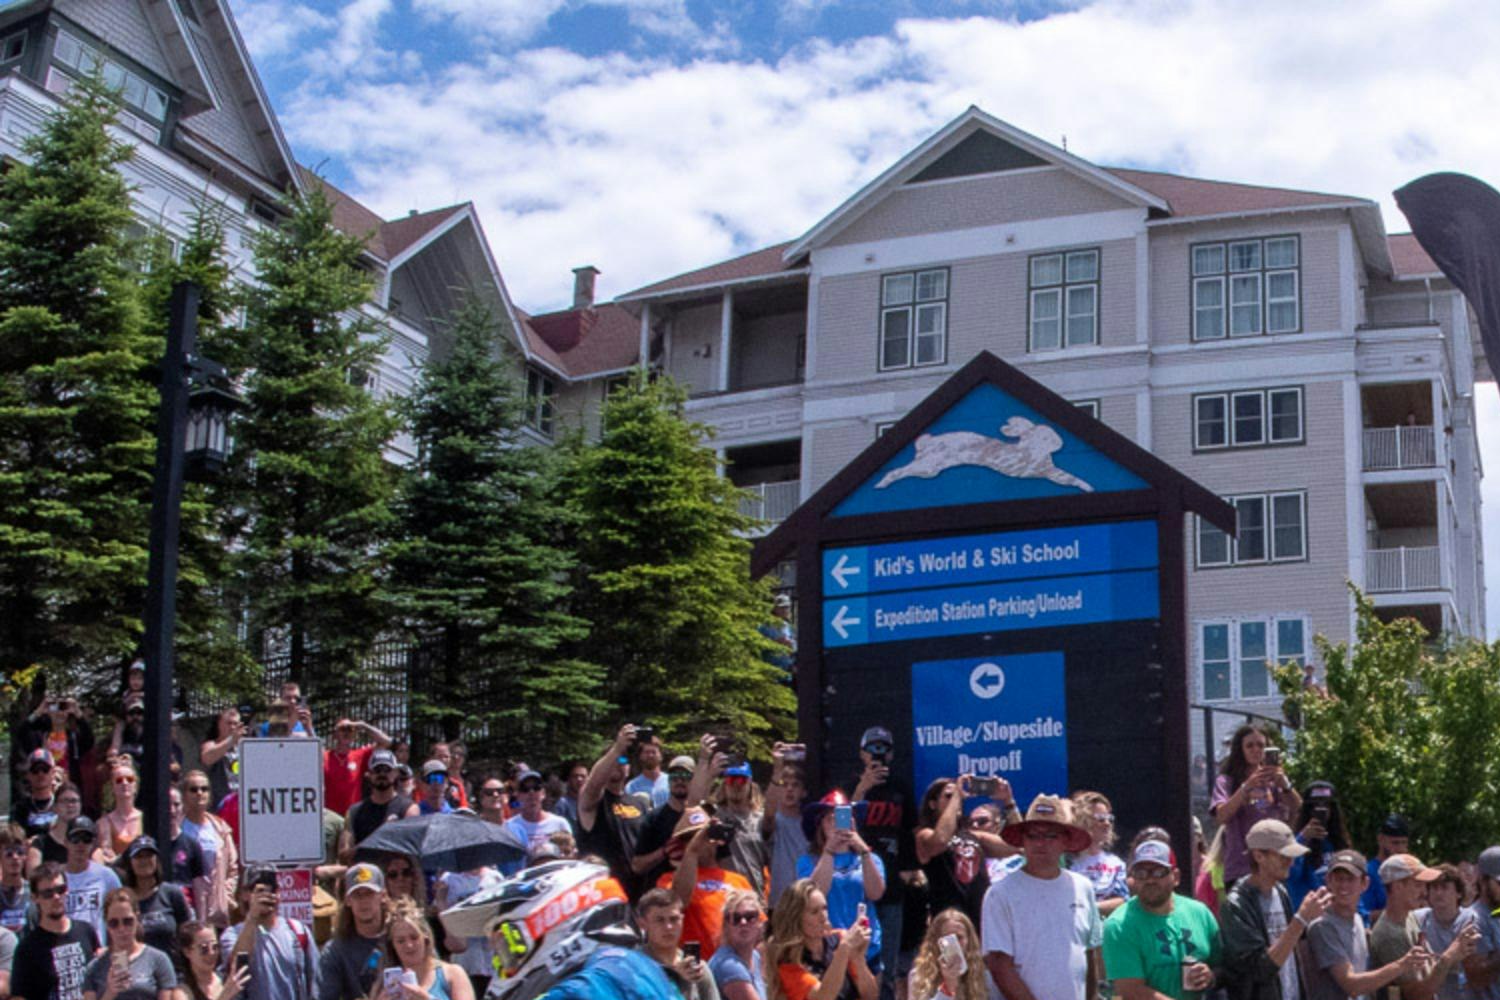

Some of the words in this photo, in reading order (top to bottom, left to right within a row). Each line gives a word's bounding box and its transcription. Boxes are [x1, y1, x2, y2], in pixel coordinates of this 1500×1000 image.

[874, 556, 914, 577] Kid's
[919, 549, 967, 573] World
[972, 549, 985, 568] &
[991, 544, 1017, 566] Ski
[1022, 540, 1080, 563] School
[874, 604, 939, 630] Expedition
[941, 599, 986, 622] Station
[988, 590, 1083, 618] Parking/Unload
[916, 717, 1064, 748] Village/Slopeside
[958, 750, 1022, 777] Dropoff
[247, 787, 317, 815] ENTER
[532, 883, 603, 937] 100%
[549, 938, 584, 967] 514
